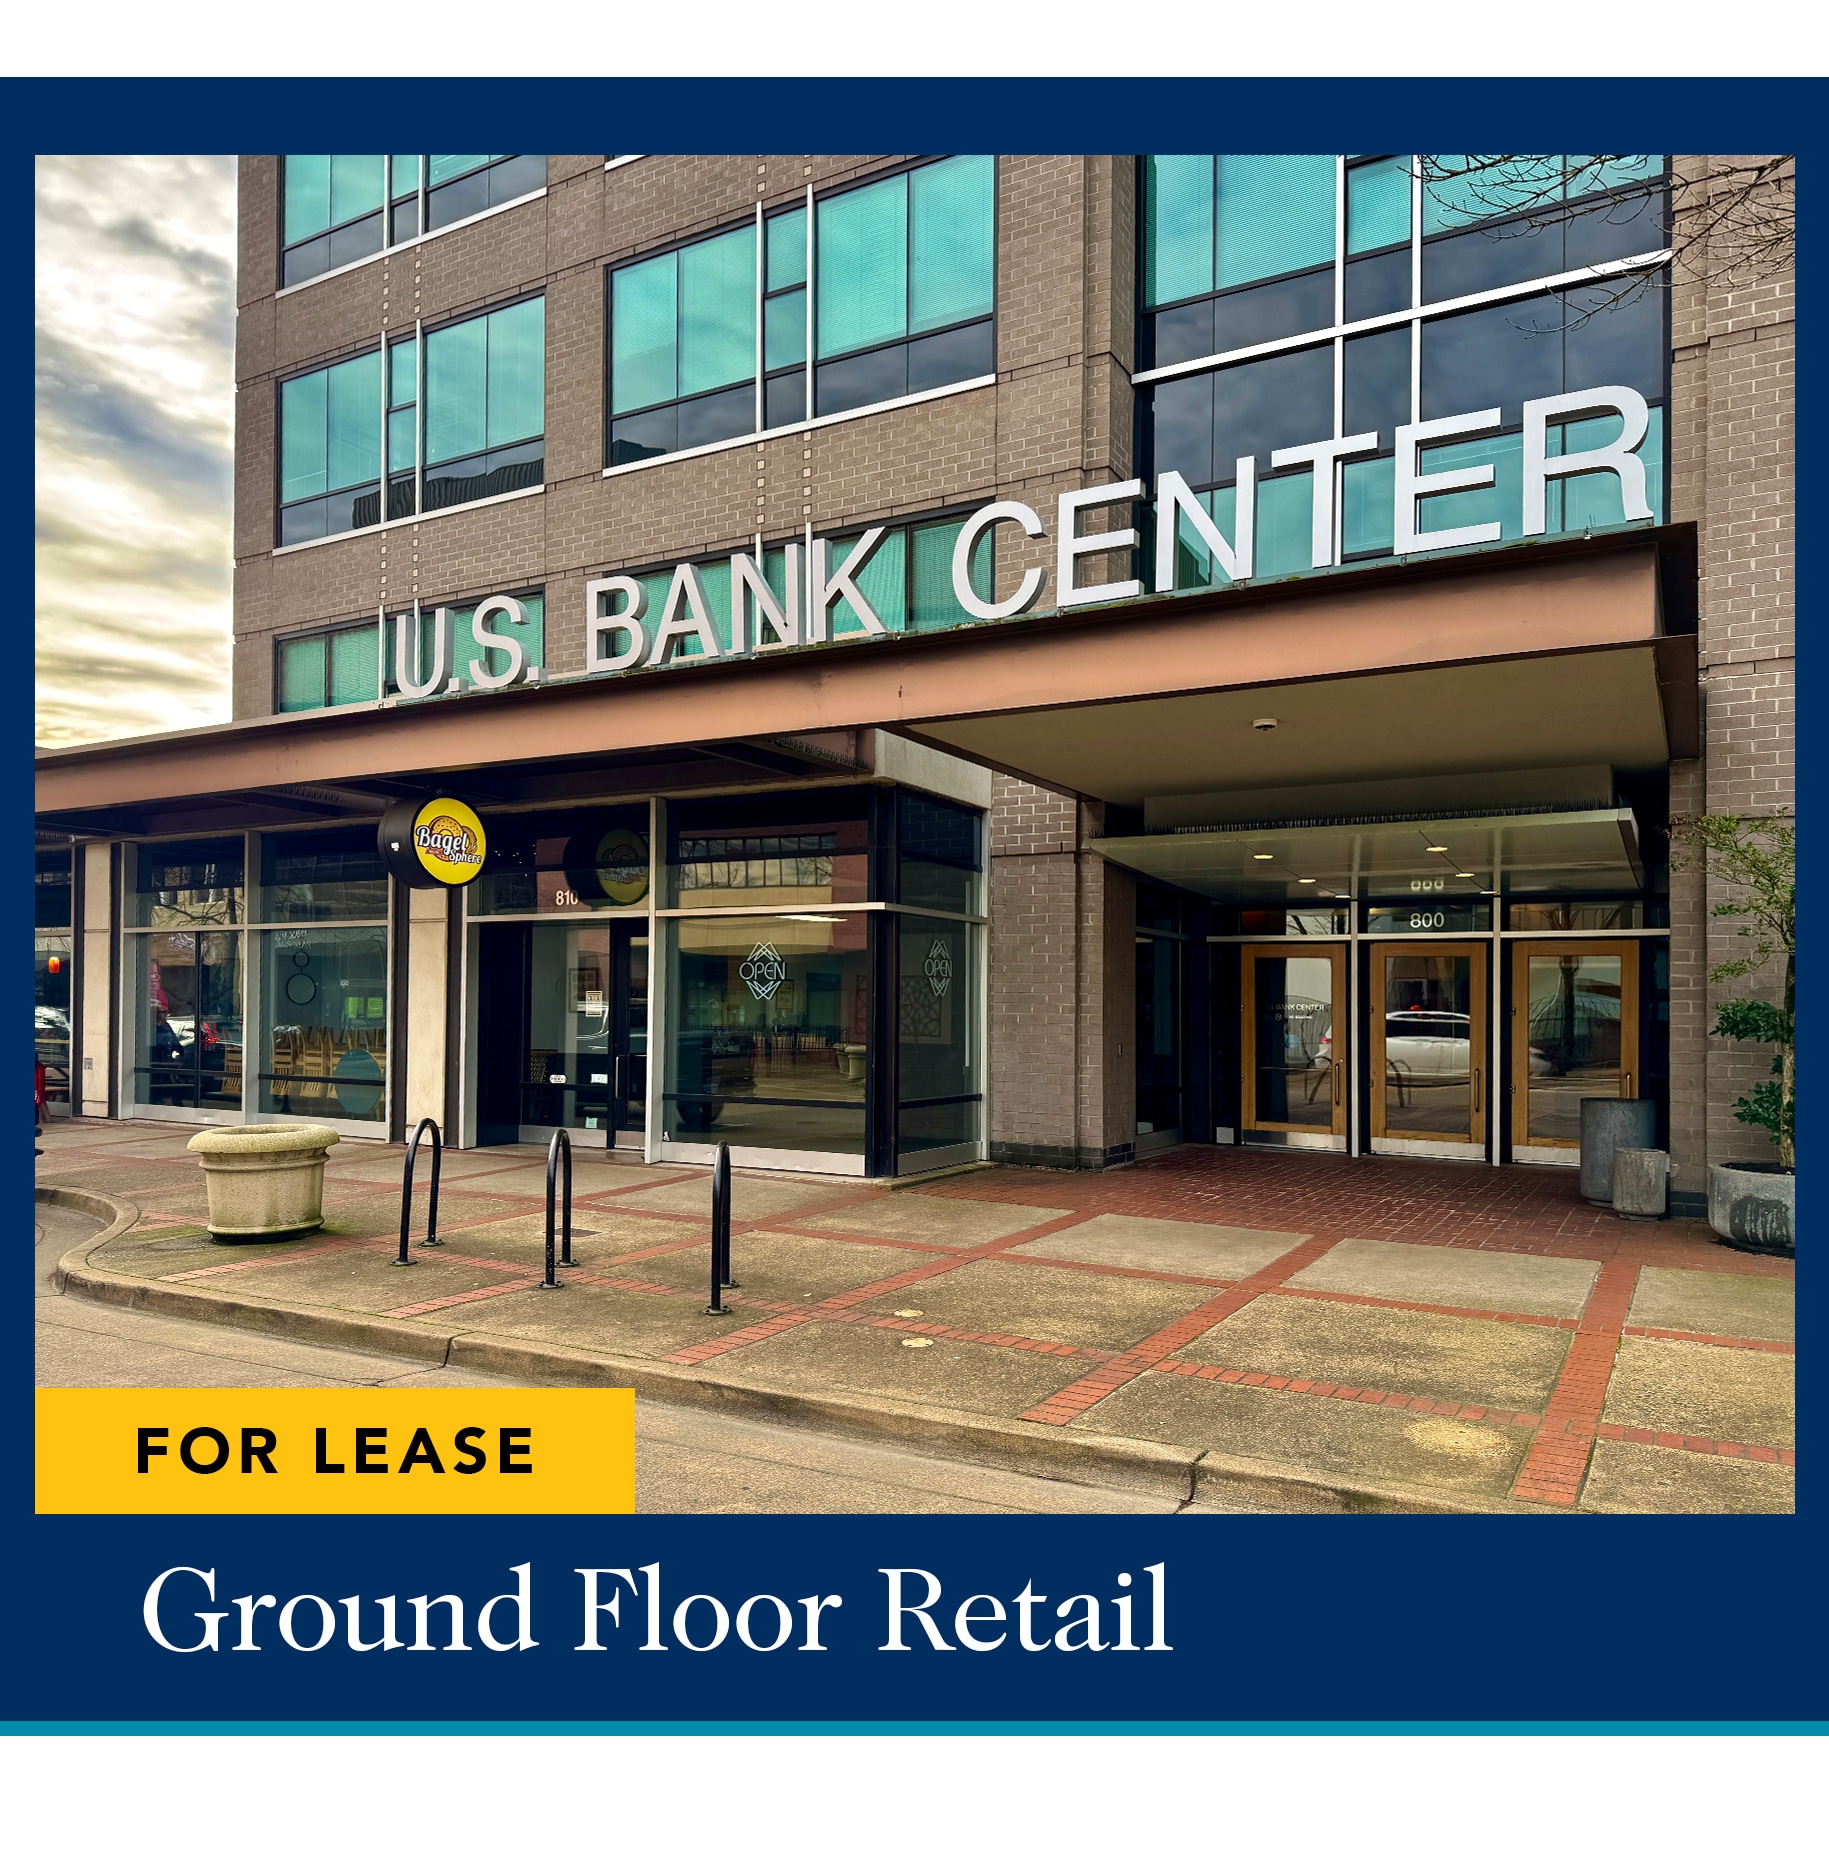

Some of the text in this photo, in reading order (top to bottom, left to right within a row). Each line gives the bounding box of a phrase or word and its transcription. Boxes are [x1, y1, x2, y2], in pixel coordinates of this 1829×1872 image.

[395, 385, 1655, 699] U.S. BANK CENTER
[416, 826, 468, 855] Bagel
[449, 850, 481, 864] Sphere
[555, 890, 579, 906] 810
[1410, 912, 1445, 928] 800
[739, 961, 785, 980] OPEN
[925, 959, 952, 977] OPEN
[1296, 1003, 1325, 1011] CENTER
